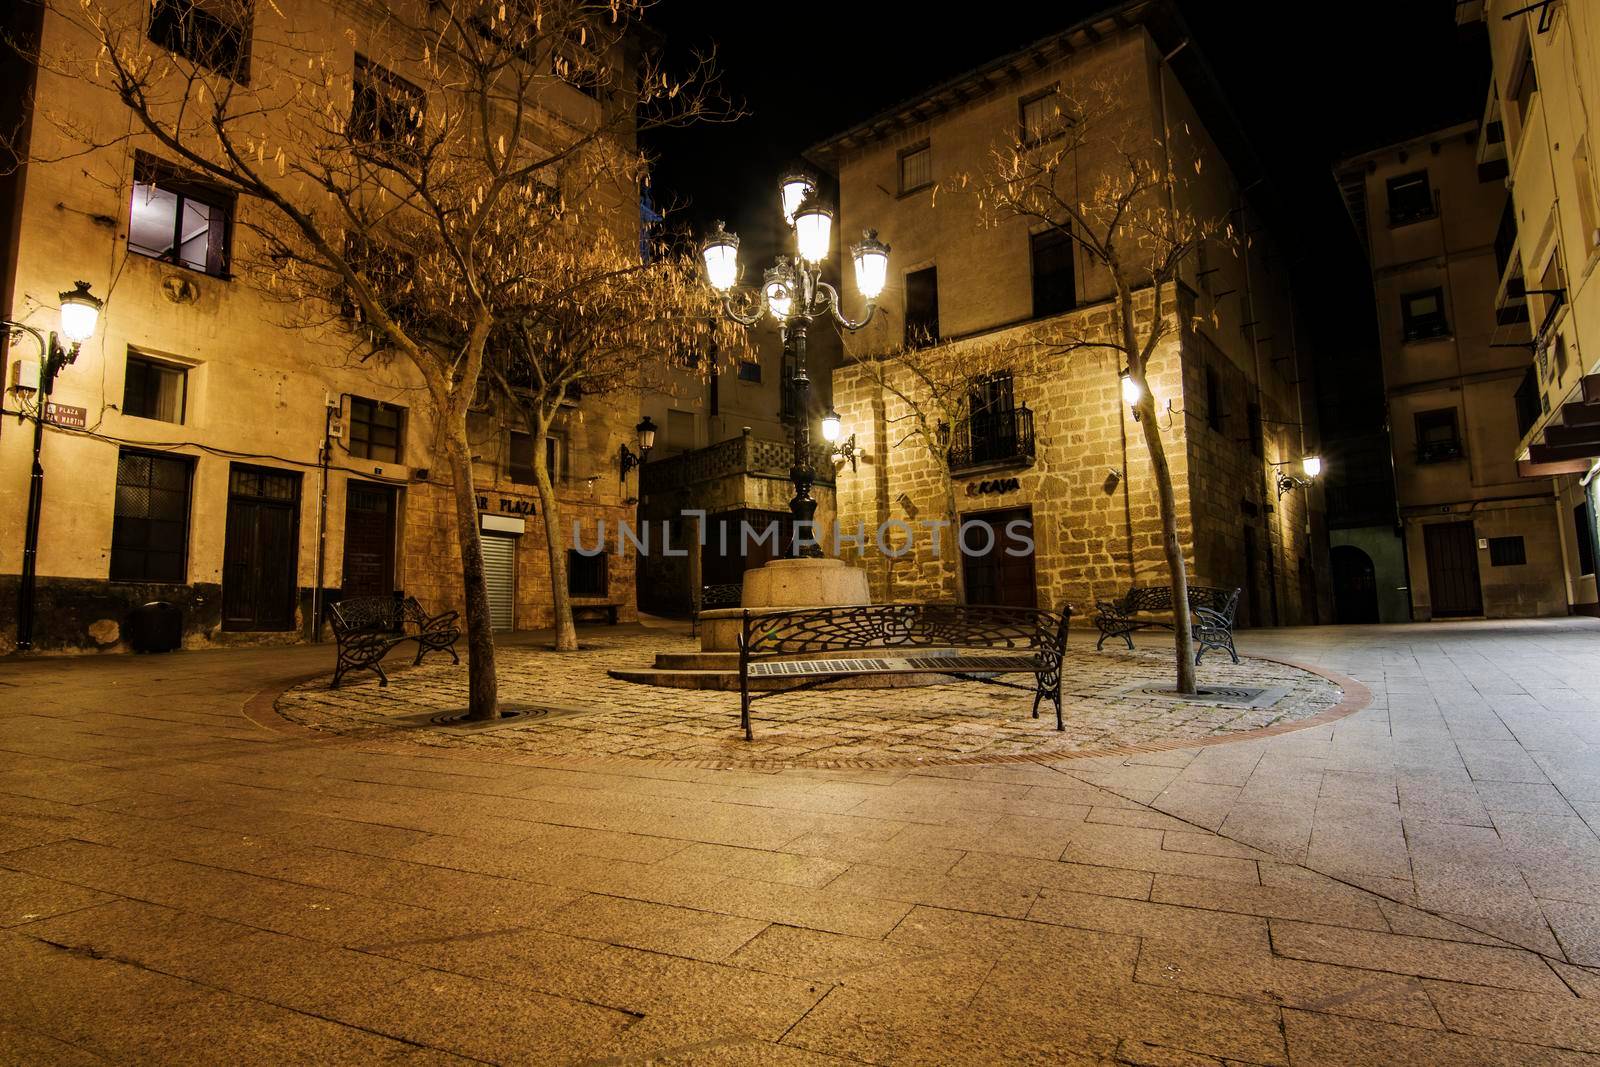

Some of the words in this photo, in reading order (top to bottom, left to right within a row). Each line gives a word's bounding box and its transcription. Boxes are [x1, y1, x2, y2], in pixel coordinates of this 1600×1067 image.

[58, 406, 79, 415] PLAZA
[46, 414, 58, 423] SAN
[475, 494, 489, 510] AR
[499, 498, 537, 516] PLAZA
